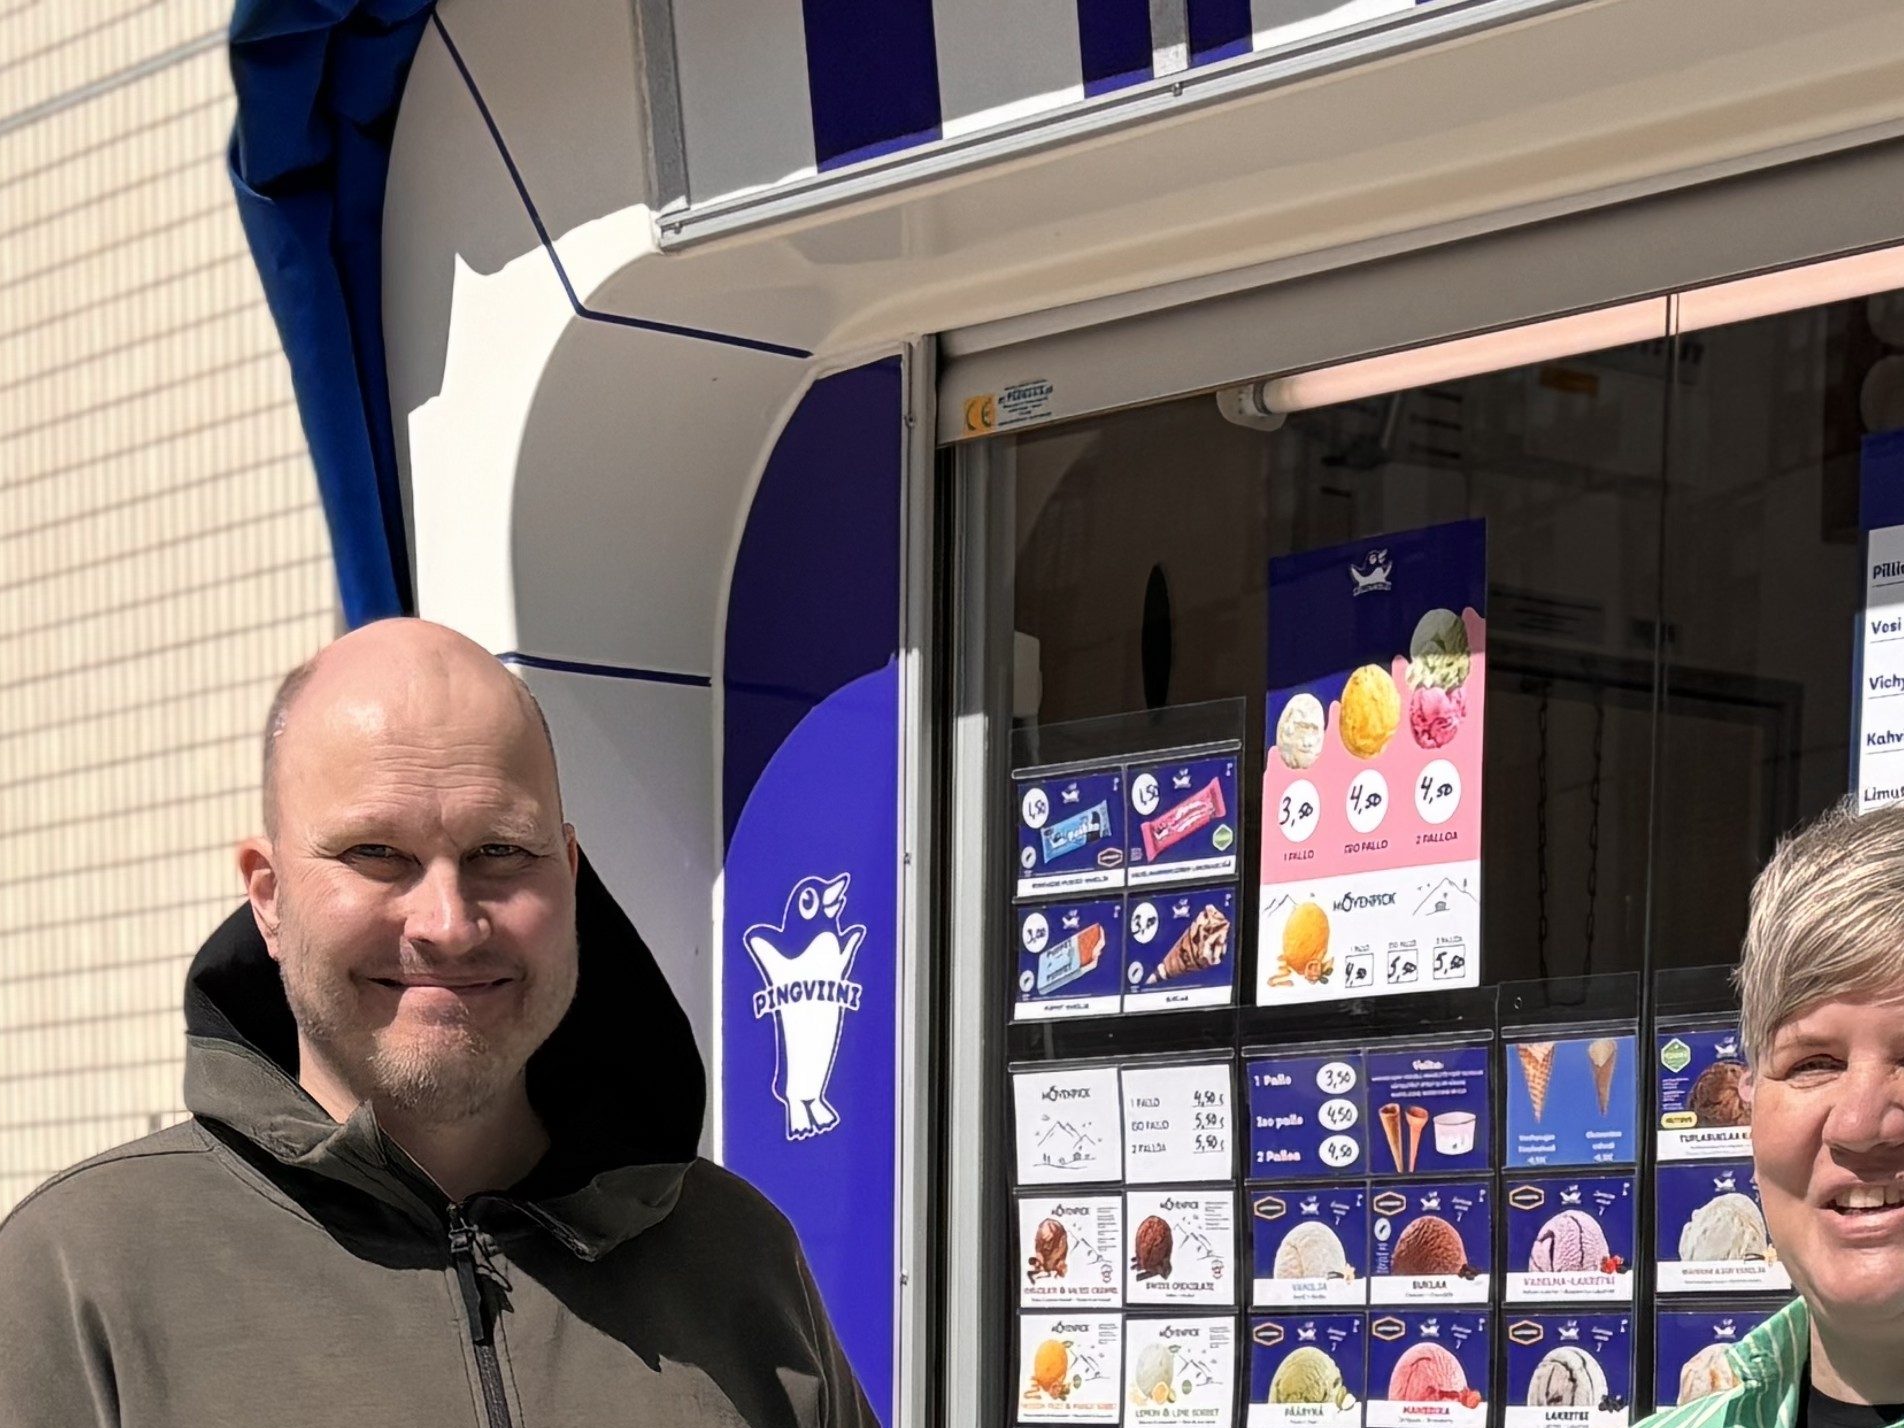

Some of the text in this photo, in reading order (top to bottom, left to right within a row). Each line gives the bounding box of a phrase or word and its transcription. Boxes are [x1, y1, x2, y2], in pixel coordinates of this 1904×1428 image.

[1871, 616, 1902, 636] Vesi
[1420, 776, 1453, 804] 4,50
[756, 979, 859, 1016] PINGVIINI
[1325, 1070, 1350, 1089] 3,50
[1327, 1106, 1353, 1125] 4,50
